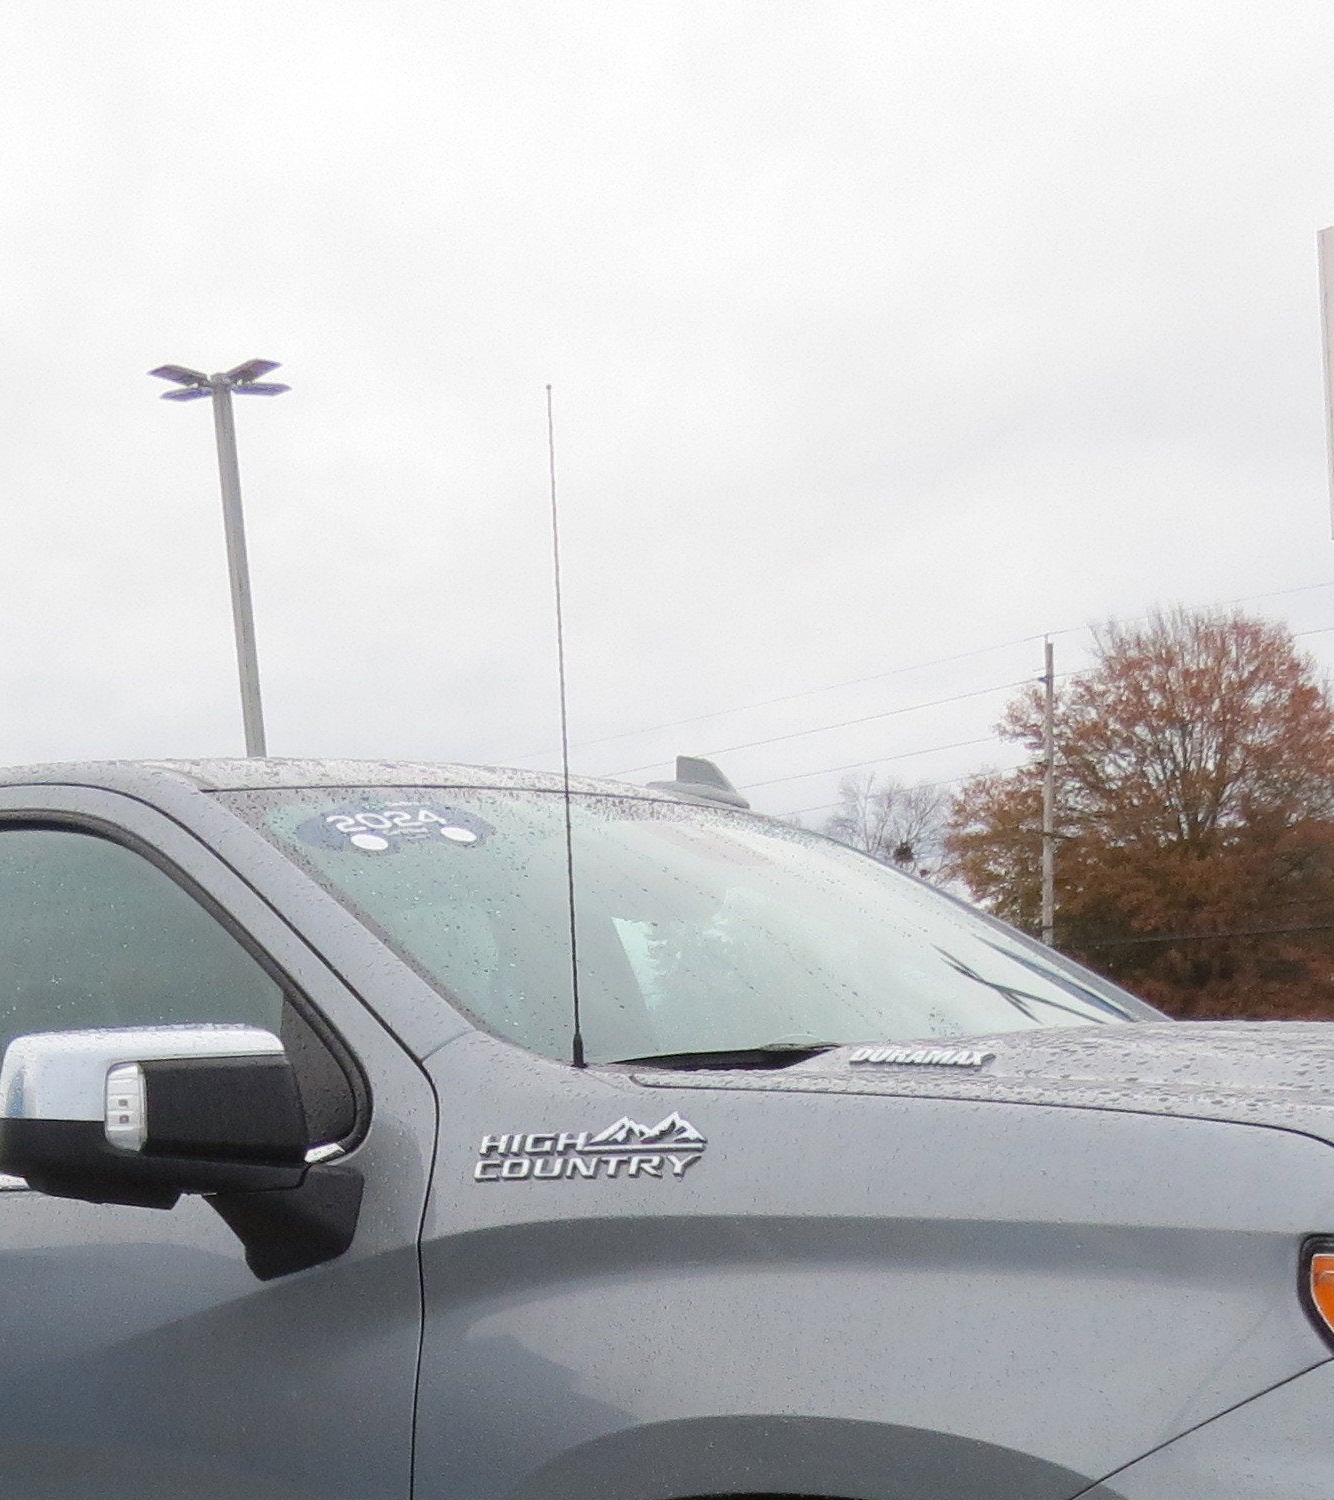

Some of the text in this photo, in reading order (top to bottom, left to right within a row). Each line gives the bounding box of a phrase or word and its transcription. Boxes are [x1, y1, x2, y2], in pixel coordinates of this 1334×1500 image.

[326, 810, 447, 833] 2024
[850, 1047, 987, 1066] DURAMAX
[479, 1131, 587, 1155] HIGH
[474, 1155, 702, 1181] COUNTRY
